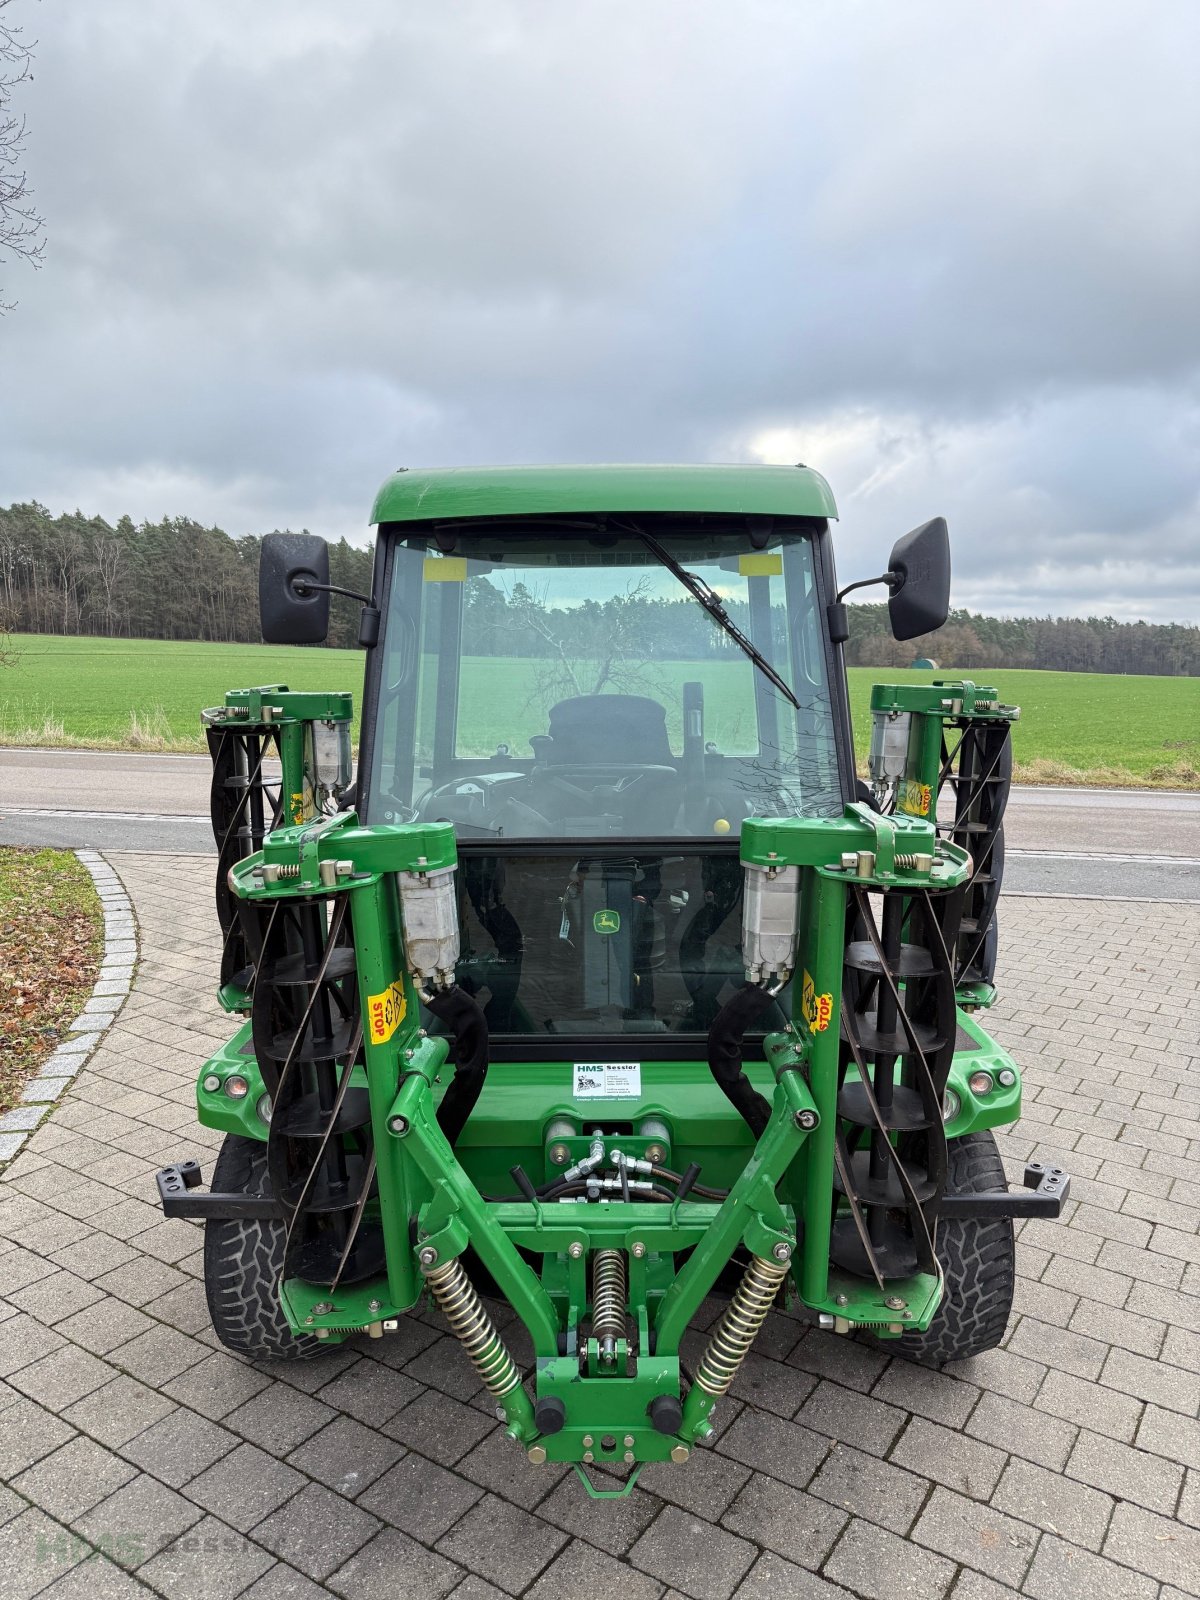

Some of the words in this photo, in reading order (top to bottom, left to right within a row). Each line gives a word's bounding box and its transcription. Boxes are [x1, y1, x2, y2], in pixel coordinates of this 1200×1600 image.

[373, 1002, 385, 1037] STOP
[819, 997, 830, 1031] STOP
[577, 1065, 604, 1073] HMS
